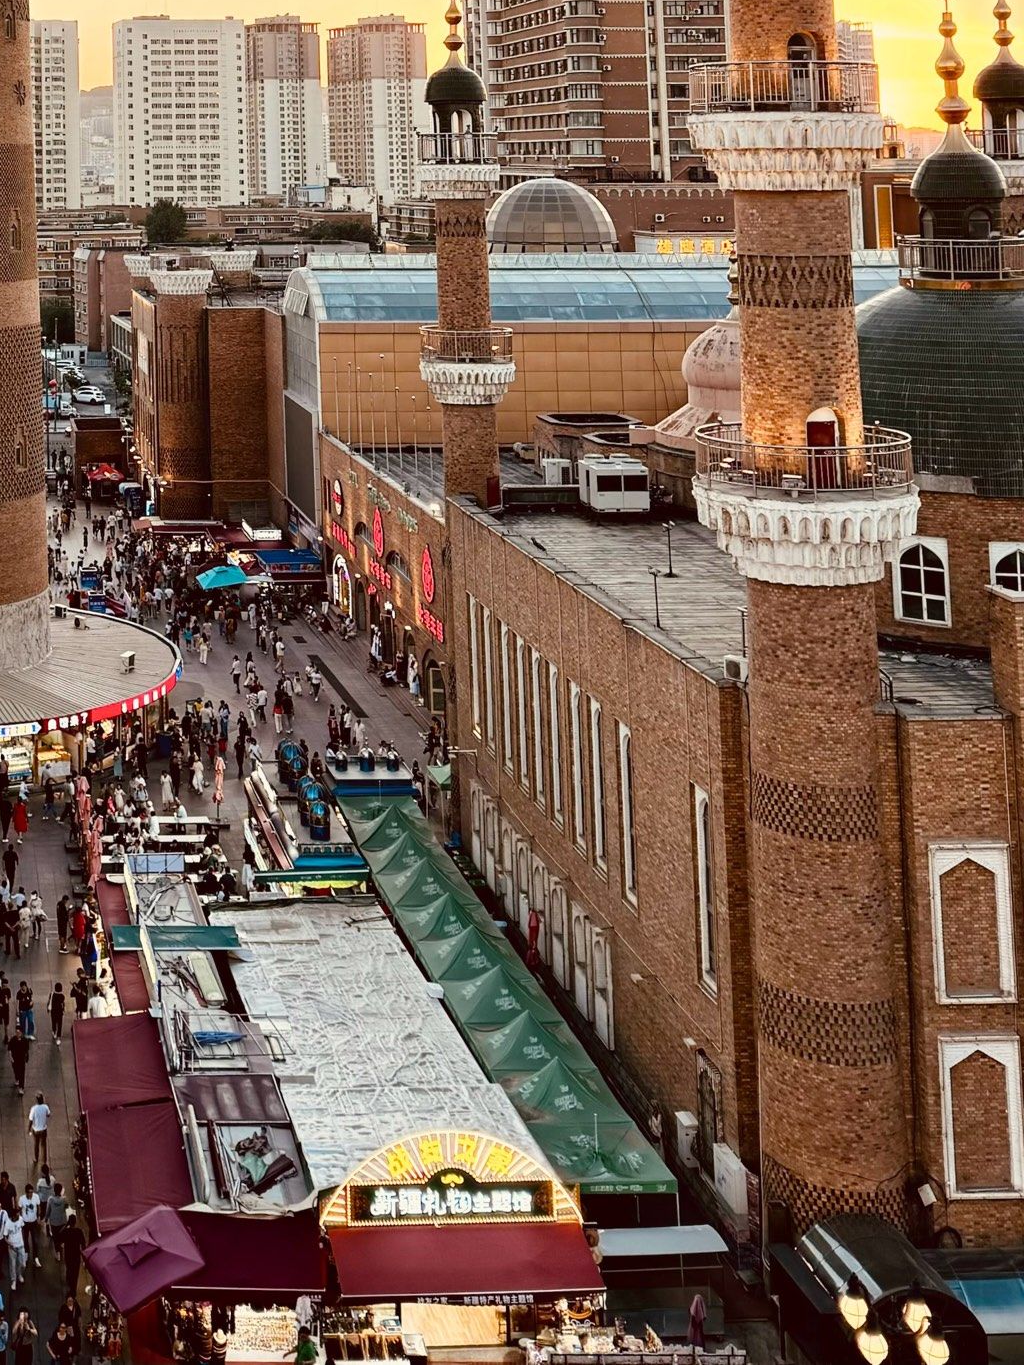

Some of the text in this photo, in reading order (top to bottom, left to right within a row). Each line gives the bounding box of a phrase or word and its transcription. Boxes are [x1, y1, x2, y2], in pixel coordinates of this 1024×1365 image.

[370, 1186, 532, 1218] 新疆礼物主题馆
